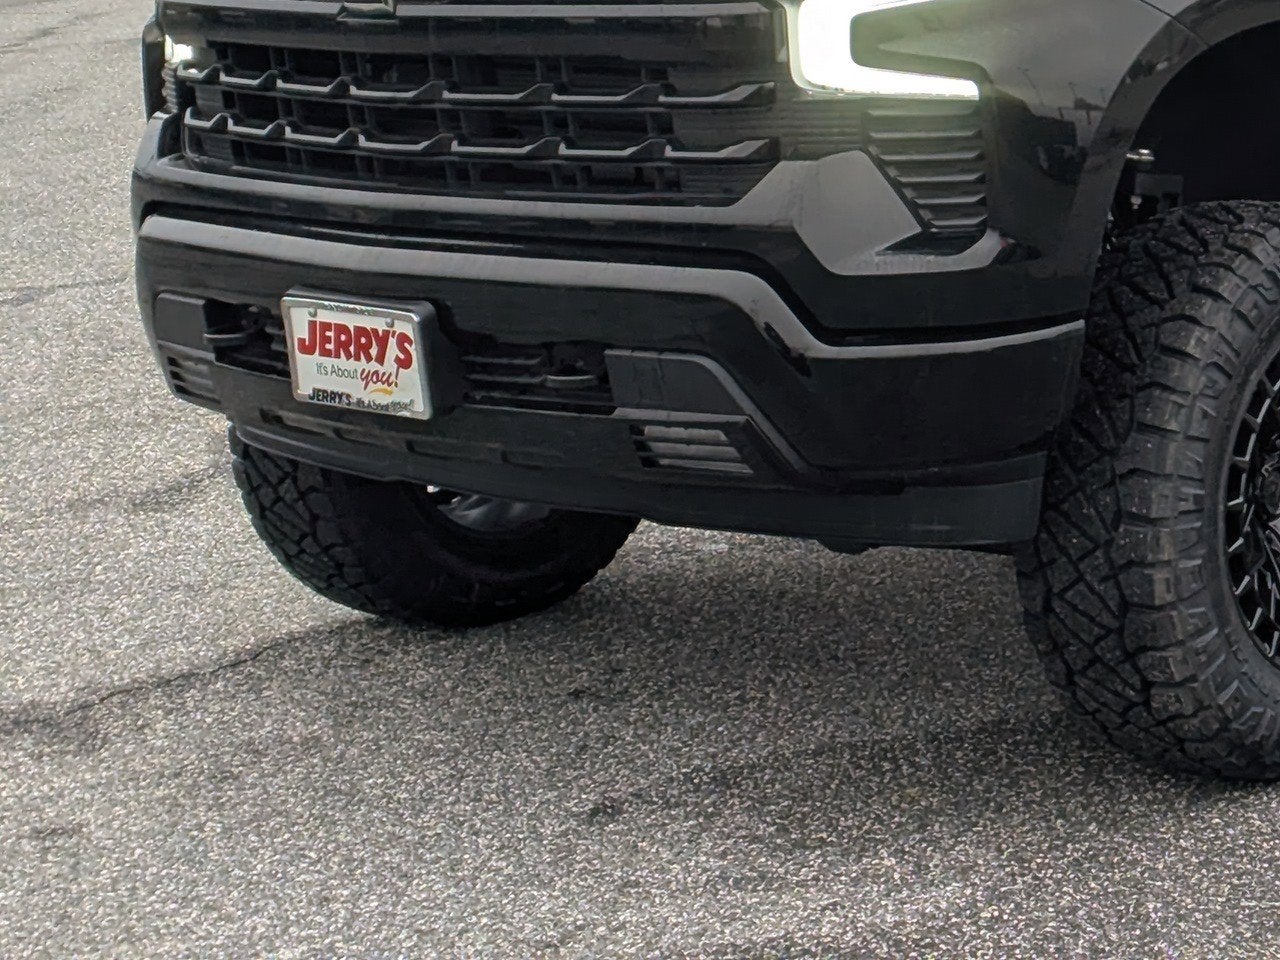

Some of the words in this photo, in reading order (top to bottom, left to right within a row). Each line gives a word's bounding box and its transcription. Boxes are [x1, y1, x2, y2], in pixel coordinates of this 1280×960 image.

[297, 319, 414, 370] JERRY'S
[316, 362, 329, 376] It's
[330, 364, 359, 380] About
[359, 364, 400, 391] you!
[308, 387, 352, 406] JERRY'S
